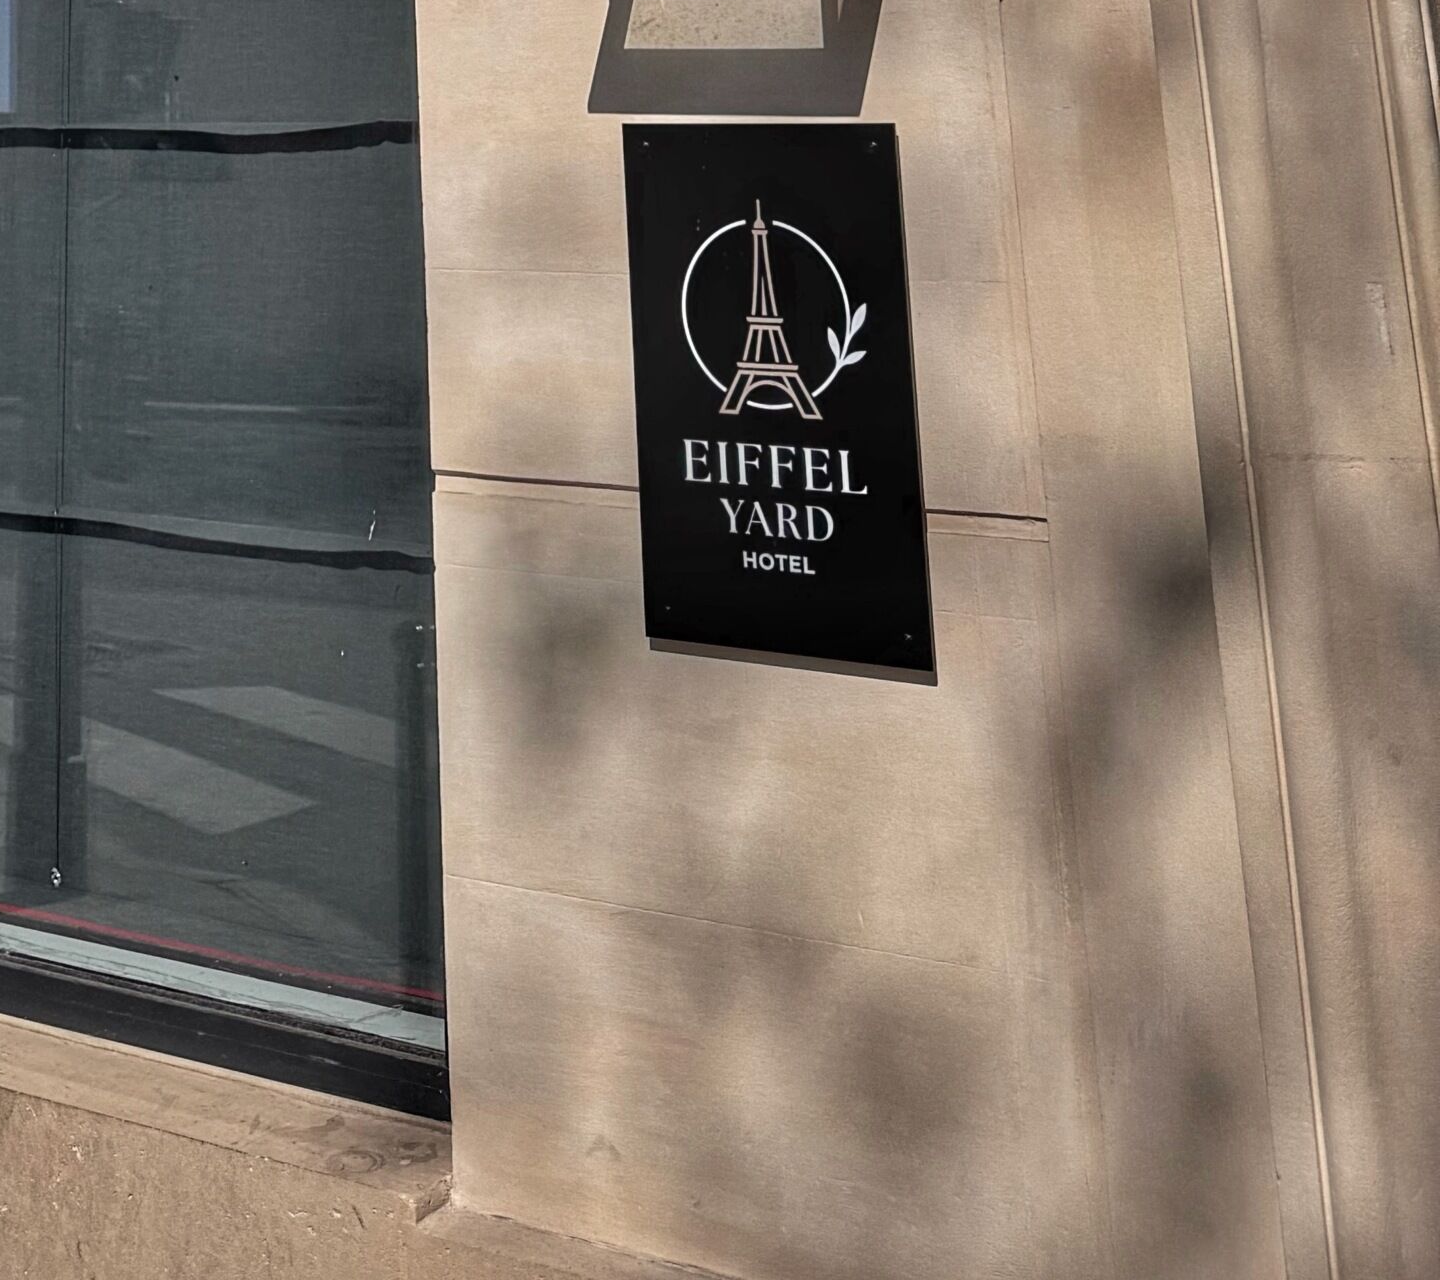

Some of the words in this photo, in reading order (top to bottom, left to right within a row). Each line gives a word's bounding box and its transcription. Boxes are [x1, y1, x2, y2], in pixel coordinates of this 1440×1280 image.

[682, 438, 869, 495] EIFFEL
[719, 497, 835, 543] YARD
[742, 550, 817, 576] HOTEL
